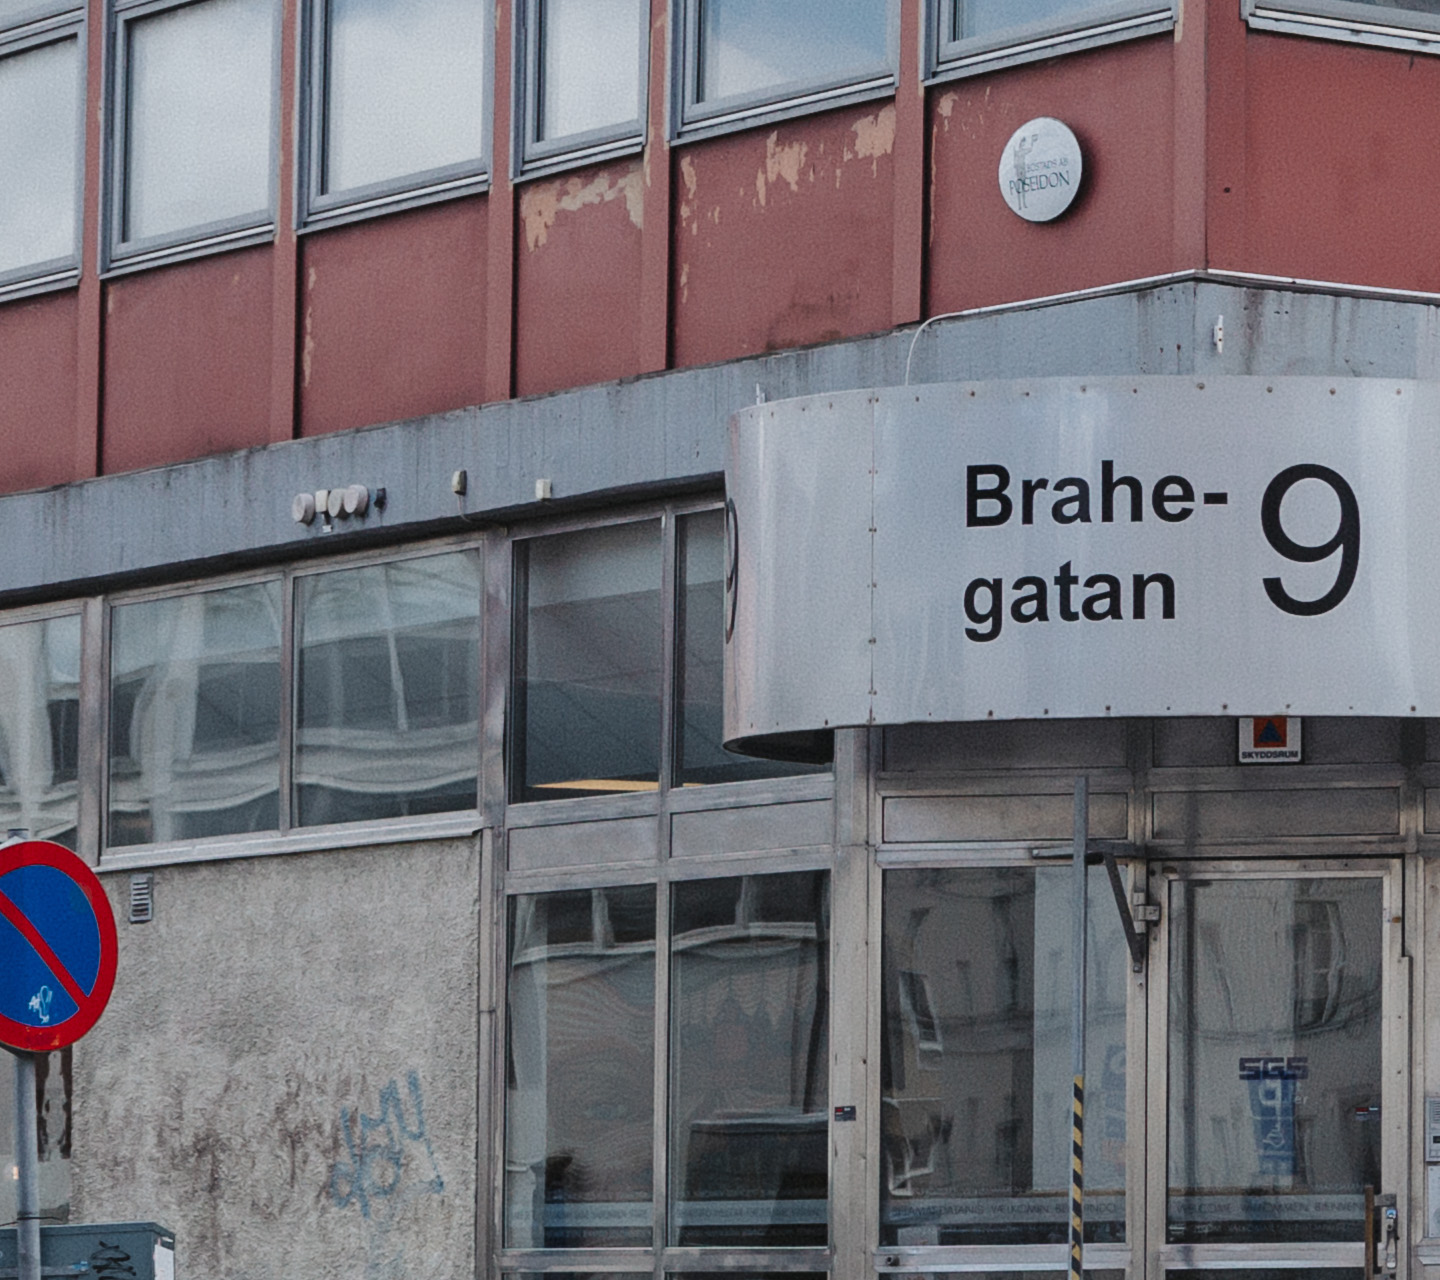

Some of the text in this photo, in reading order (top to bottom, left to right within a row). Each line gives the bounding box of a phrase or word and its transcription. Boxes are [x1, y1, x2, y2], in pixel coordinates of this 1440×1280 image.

[1008, 170, 1070, 196] POSEIDON
[966, 459, 1228, 527] Brahe-
[1261, 463, 1361, 617] 9
[963, 559, 1176, 643] gatan
[1241, 751, 1299, 759] SKYDDSRUM
[1238, 1056, 1309, 1080] SGS
